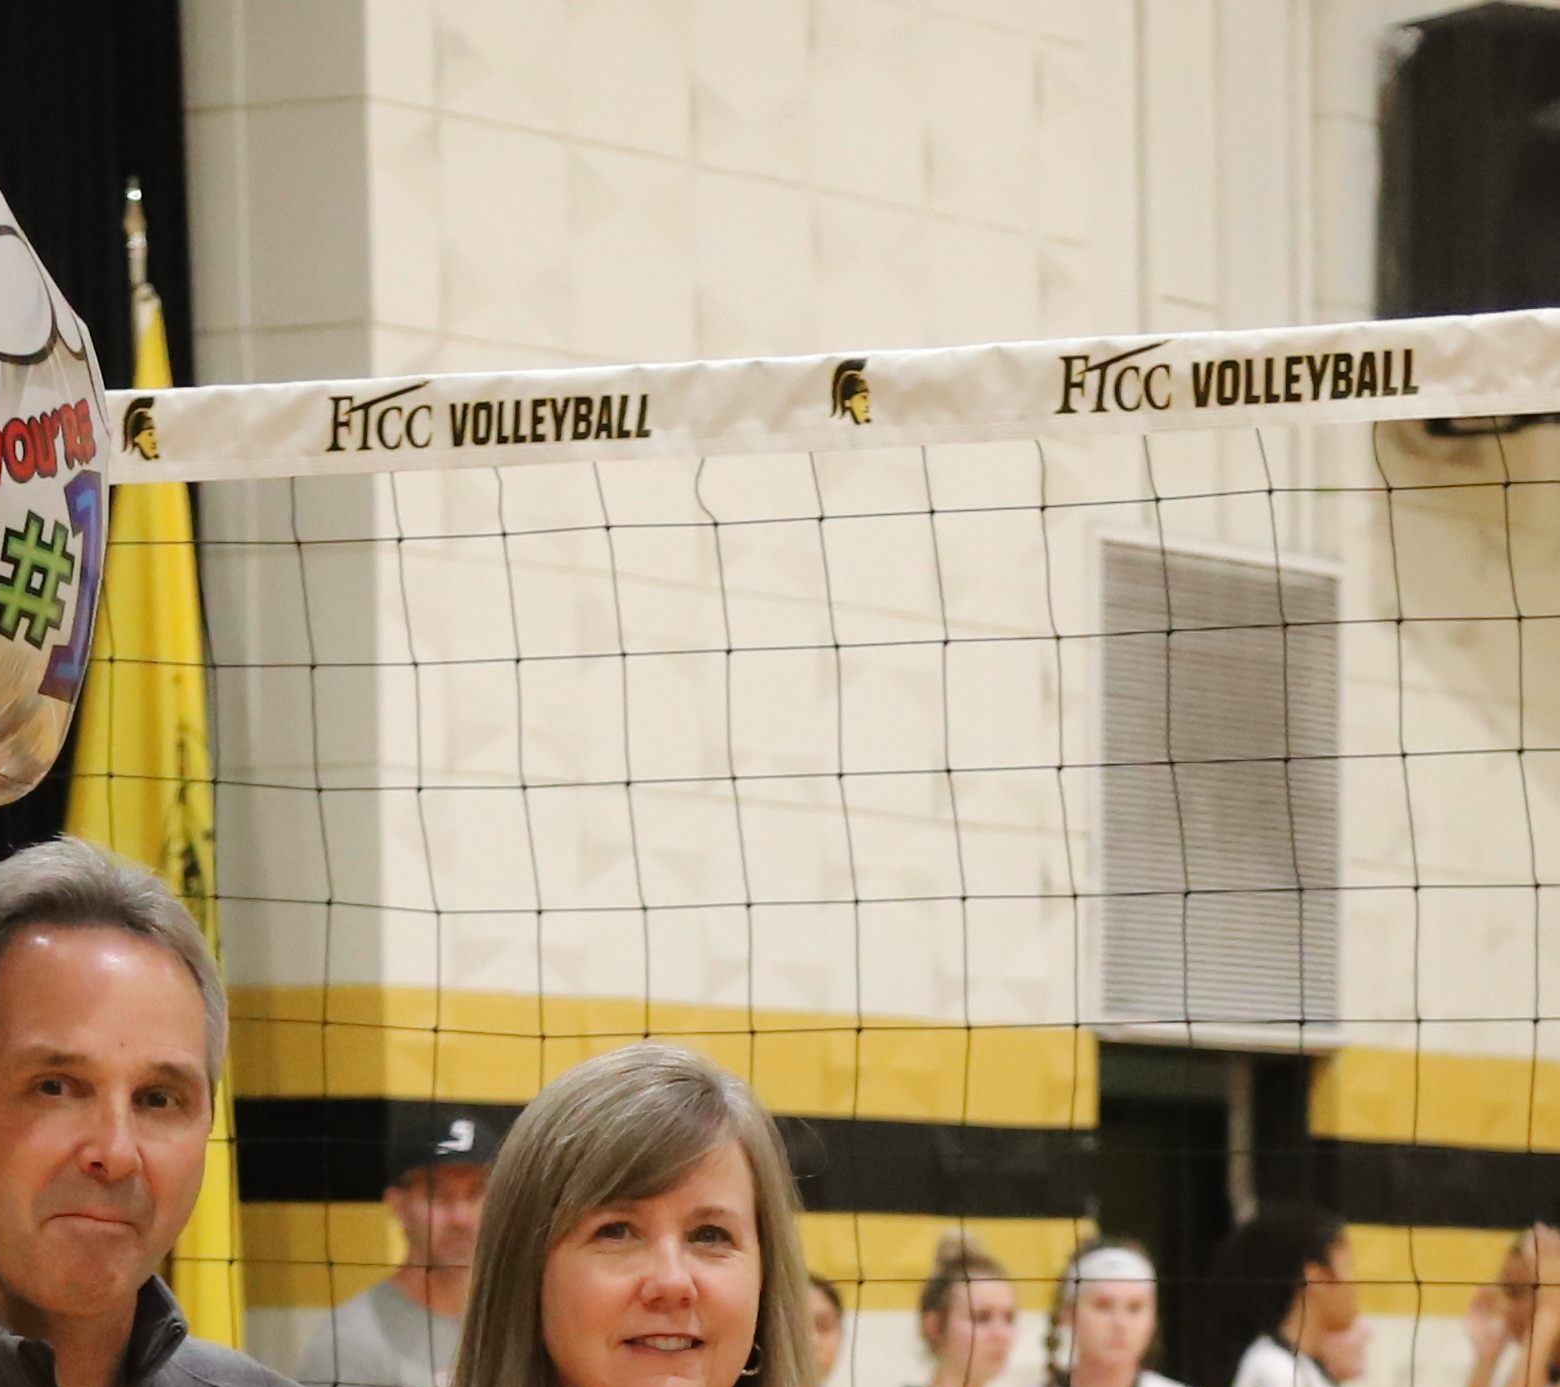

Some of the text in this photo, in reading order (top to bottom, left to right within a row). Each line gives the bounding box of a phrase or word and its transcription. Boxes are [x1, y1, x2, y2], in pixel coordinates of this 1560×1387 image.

[1055, 342, 1419, 415] FTCC VOLLEYBALL
[326, 382, 652, 453] FTCC VOLLEYBALL
